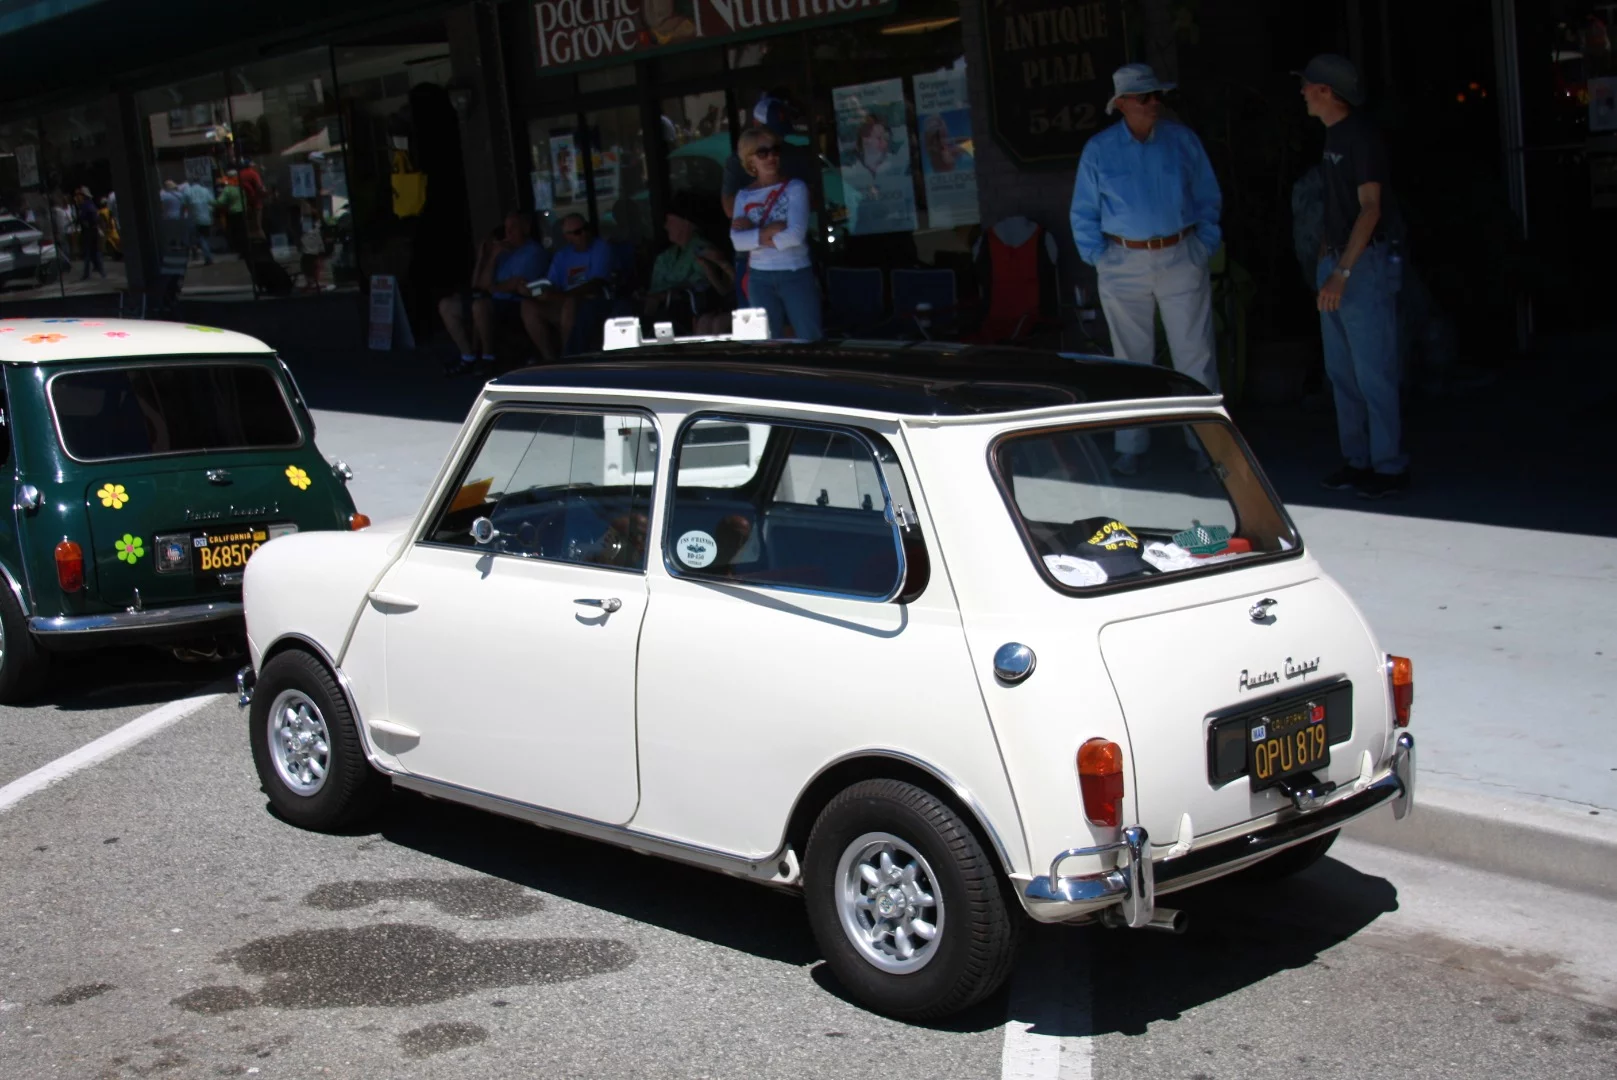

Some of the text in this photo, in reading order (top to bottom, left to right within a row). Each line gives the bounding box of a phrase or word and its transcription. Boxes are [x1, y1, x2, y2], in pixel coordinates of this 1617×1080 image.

[694, 0, 887, 38] Nutri
[1004, 2, 1108, 51] ANTIQUE
[1022, 52, 1096, 89] PLAZA
[1028, 102, 1097, 134] 542
[209, 532, 252, 544] CALIFORNIA
[1296, 723, 1325, 765] 879
